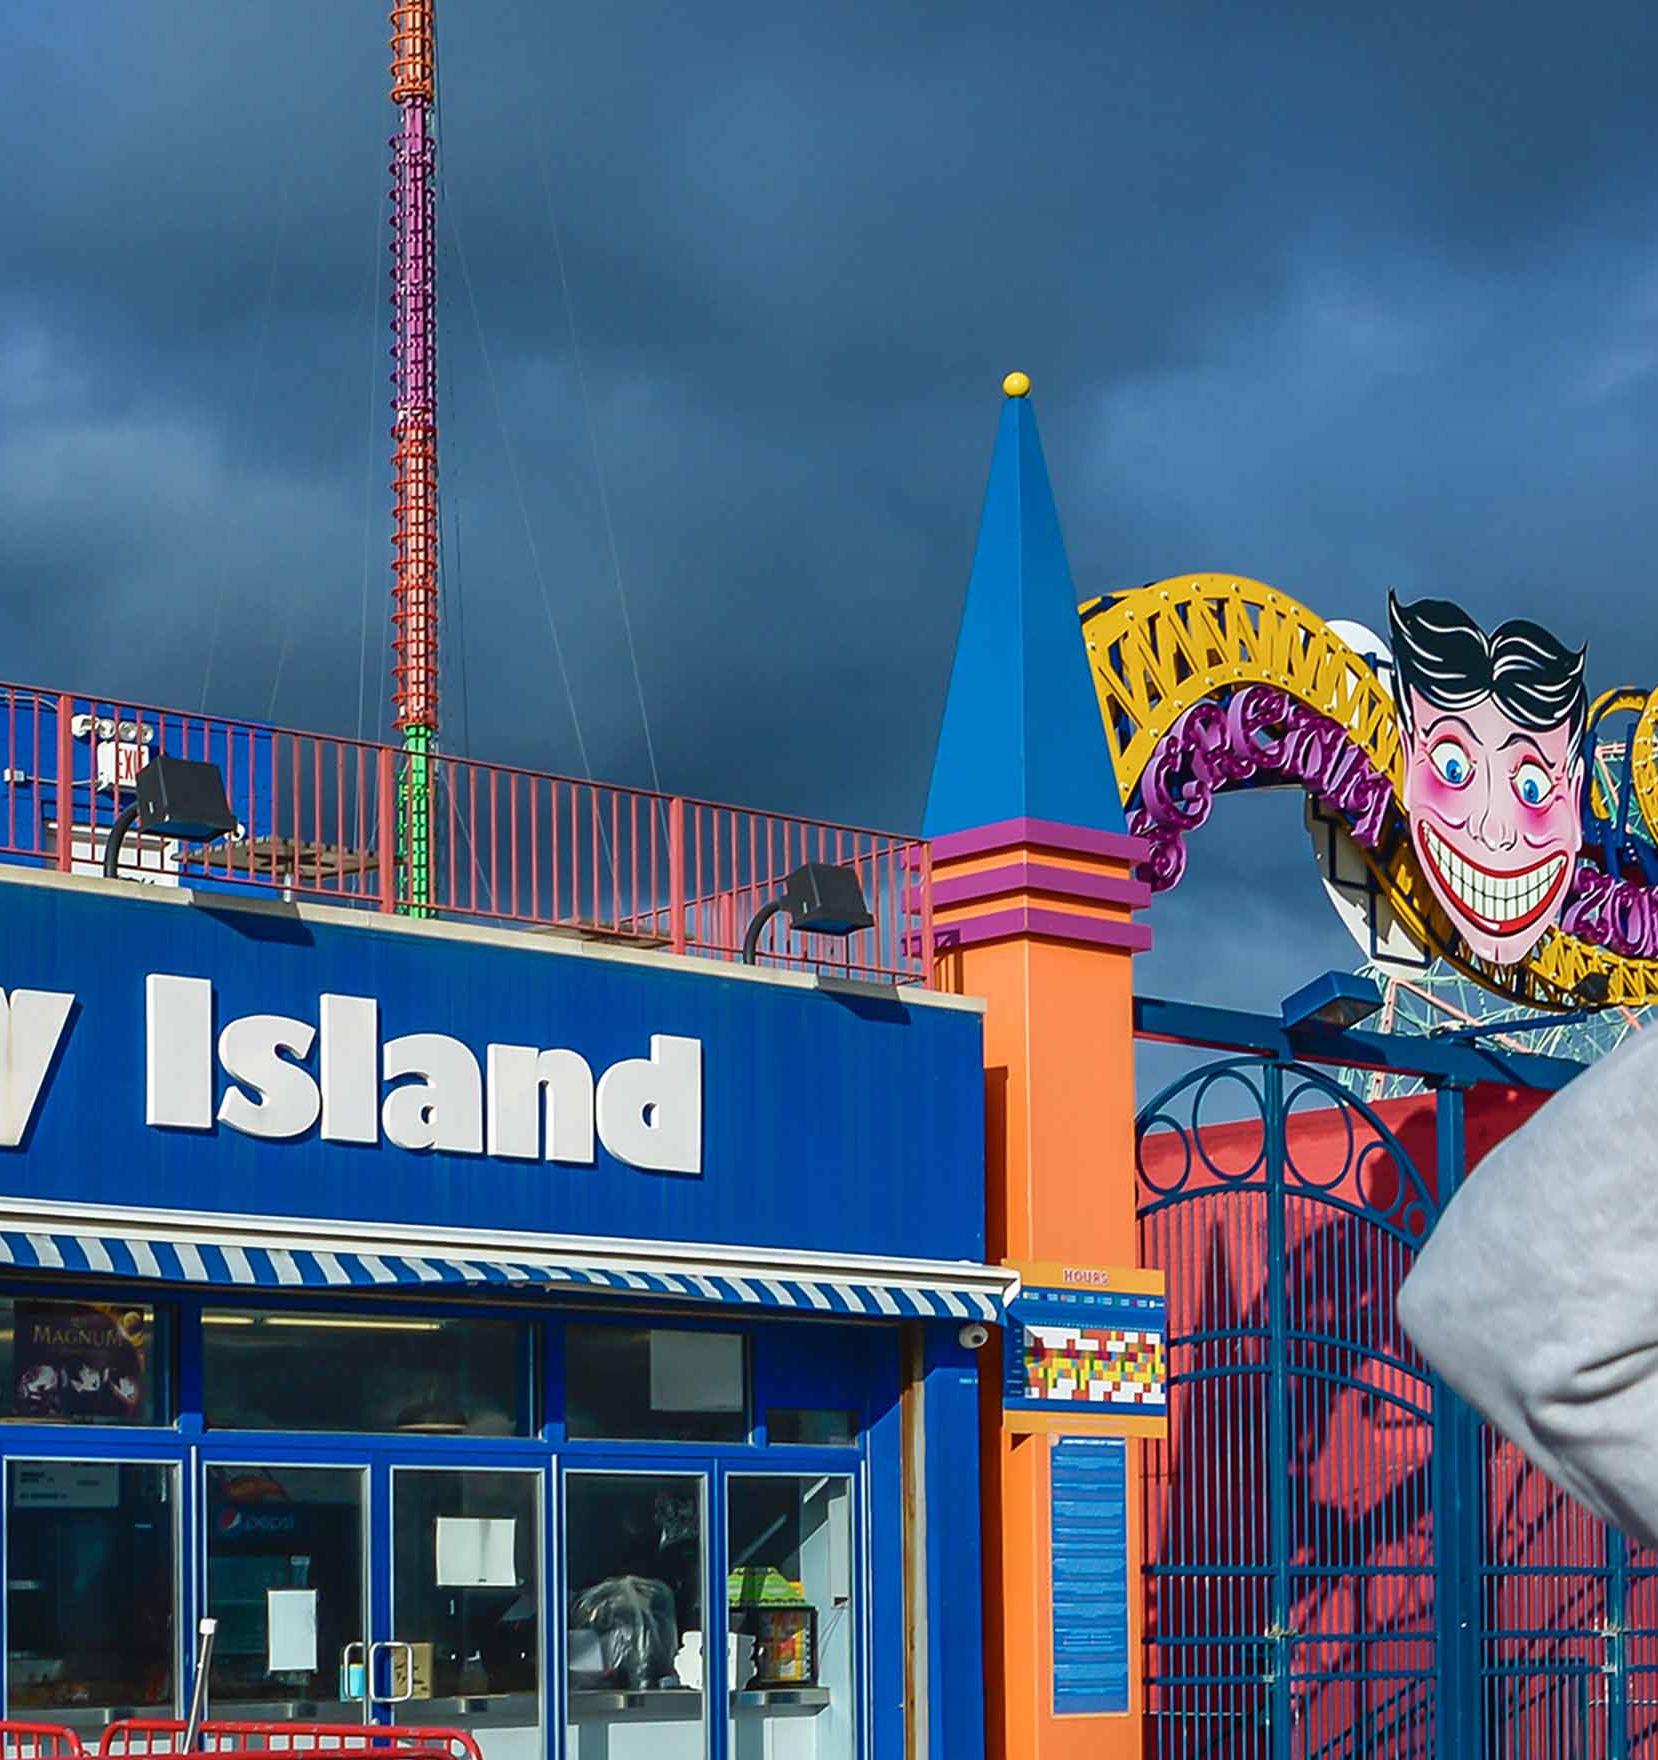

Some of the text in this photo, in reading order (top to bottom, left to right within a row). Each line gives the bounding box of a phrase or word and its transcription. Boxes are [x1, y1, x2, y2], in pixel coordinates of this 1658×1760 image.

[1127, 684, 1393, 893] SCREAM
[146, 973, 702, 1175] Island
[1062, 1268, 1110, 1286] HOURS
[33, 1325, 123, 1348] MAGNUM
[245, 1512, 294, 1534] pepsi
